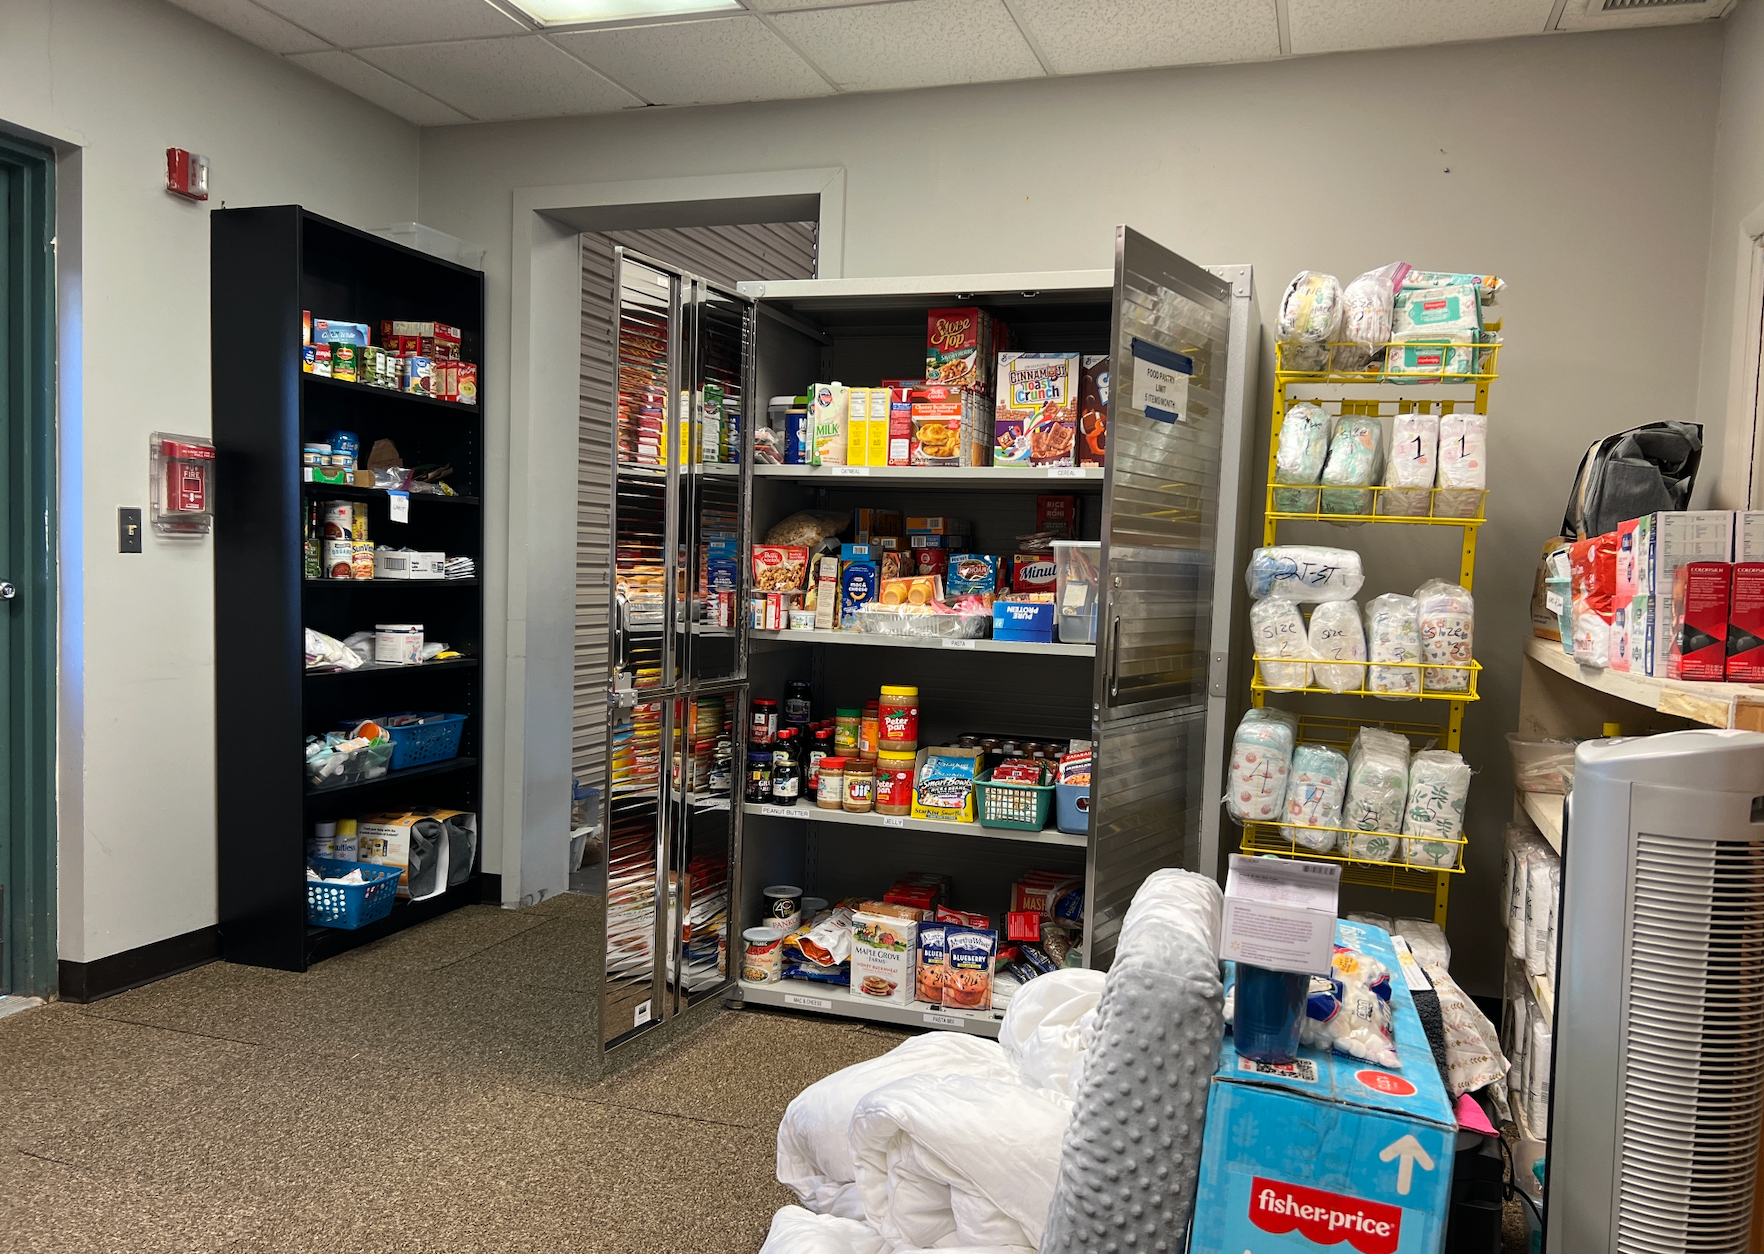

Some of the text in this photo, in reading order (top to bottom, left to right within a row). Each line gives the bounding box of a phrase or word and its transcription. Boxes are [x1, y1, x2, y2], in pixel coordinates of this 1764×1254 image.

[936, 318, 971, 336] Stove
[1147, 368, 1175, 385] FOOD PANTRY
[1023, 378, 1052, 391] Toast
[1156, 384, 1167, 394] LIMIT
[1017, 386, 1060, 402] Crunch
[816, 423, 839, 436] MILK
[1412, 436, 1425, 461] 1
[1458, 434, 1471, 459] 1
[184, 471, 201, 479] FIRE
[1047, 510, 1065, 518] RONI
[1020, 565, 1058, 580] Minut
[1007, 606, 1039, 614] PROTEIN
[1013, 612, 1033, 620] PURE
[1280, 641, 1292, 658] 2
[1332, 648, 1344, 661] 2
[1450, 642, 1461, 655] 3
[884, 717, 909, 725] Peter
[923, 777, 972, 789] Smart Bowls
[851, 785, 870, 797] Jif
[1358, 810, 1379, 831] 5
[335, 844, 356, 852] aultless
[775, 901, 791, 918] 4C
[1023, 897, 1047, 911] MASH
[772, 917, 798, 929] PANKO
[855, 947, 900, 961] MAPLE GROVE
[953, 954, 987, 963] BLUEBERRY
[872, 965, 898, 973] BUCKWHEAT
[1258, 1188, 1391, 1238] fisher-price
